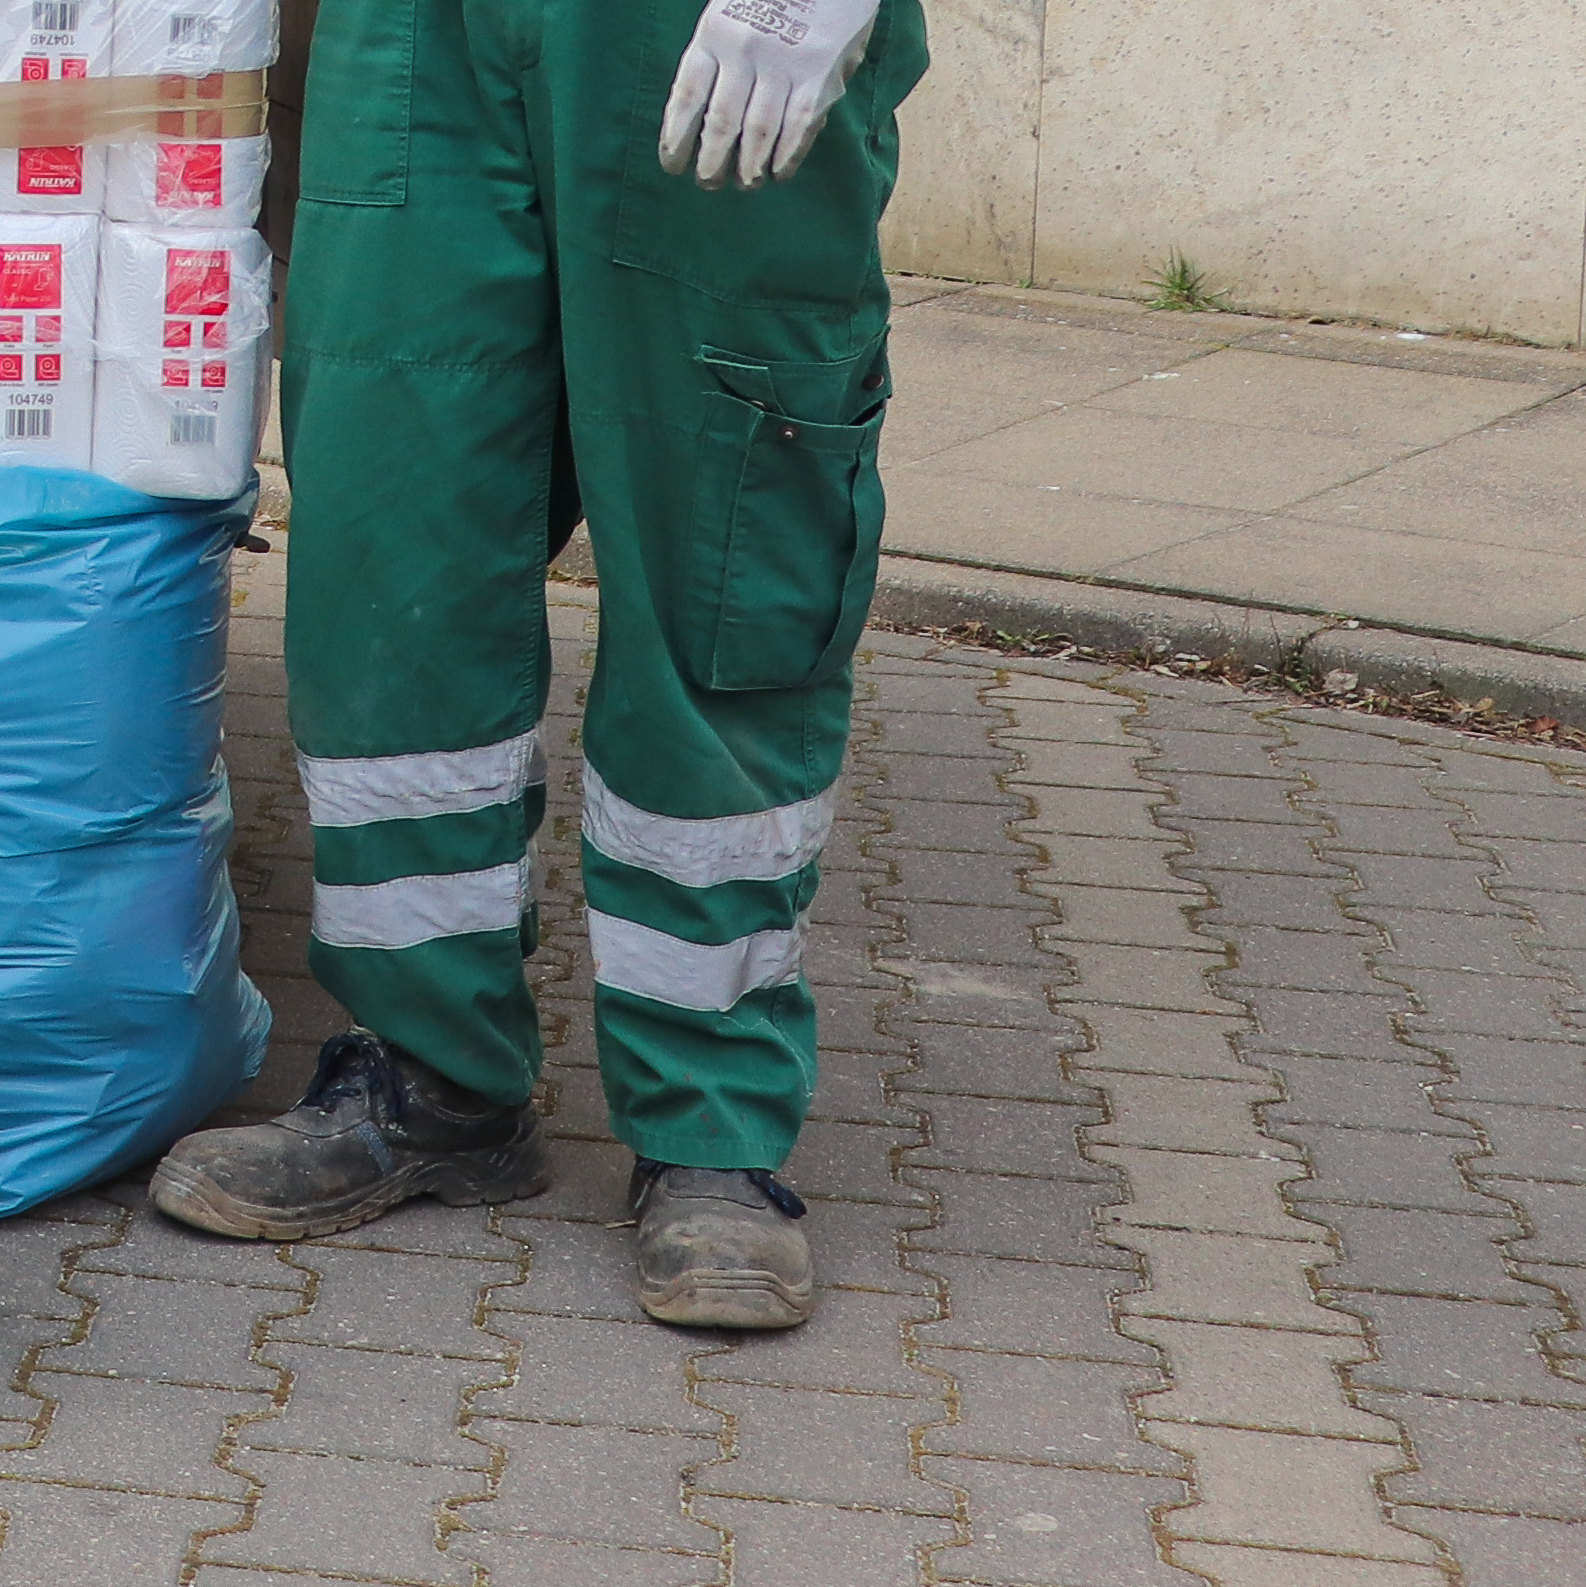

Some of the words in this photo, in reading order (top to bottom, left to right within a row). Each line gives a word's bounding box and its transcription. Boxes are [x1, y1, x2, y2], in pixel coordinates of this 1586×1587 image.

[30, 33, 76, 46] 104749
[28, 177, 76, 188] KATRIN
[3, 252, 51, 261] KATRIN
[8, 393, 54, 405] 104749
